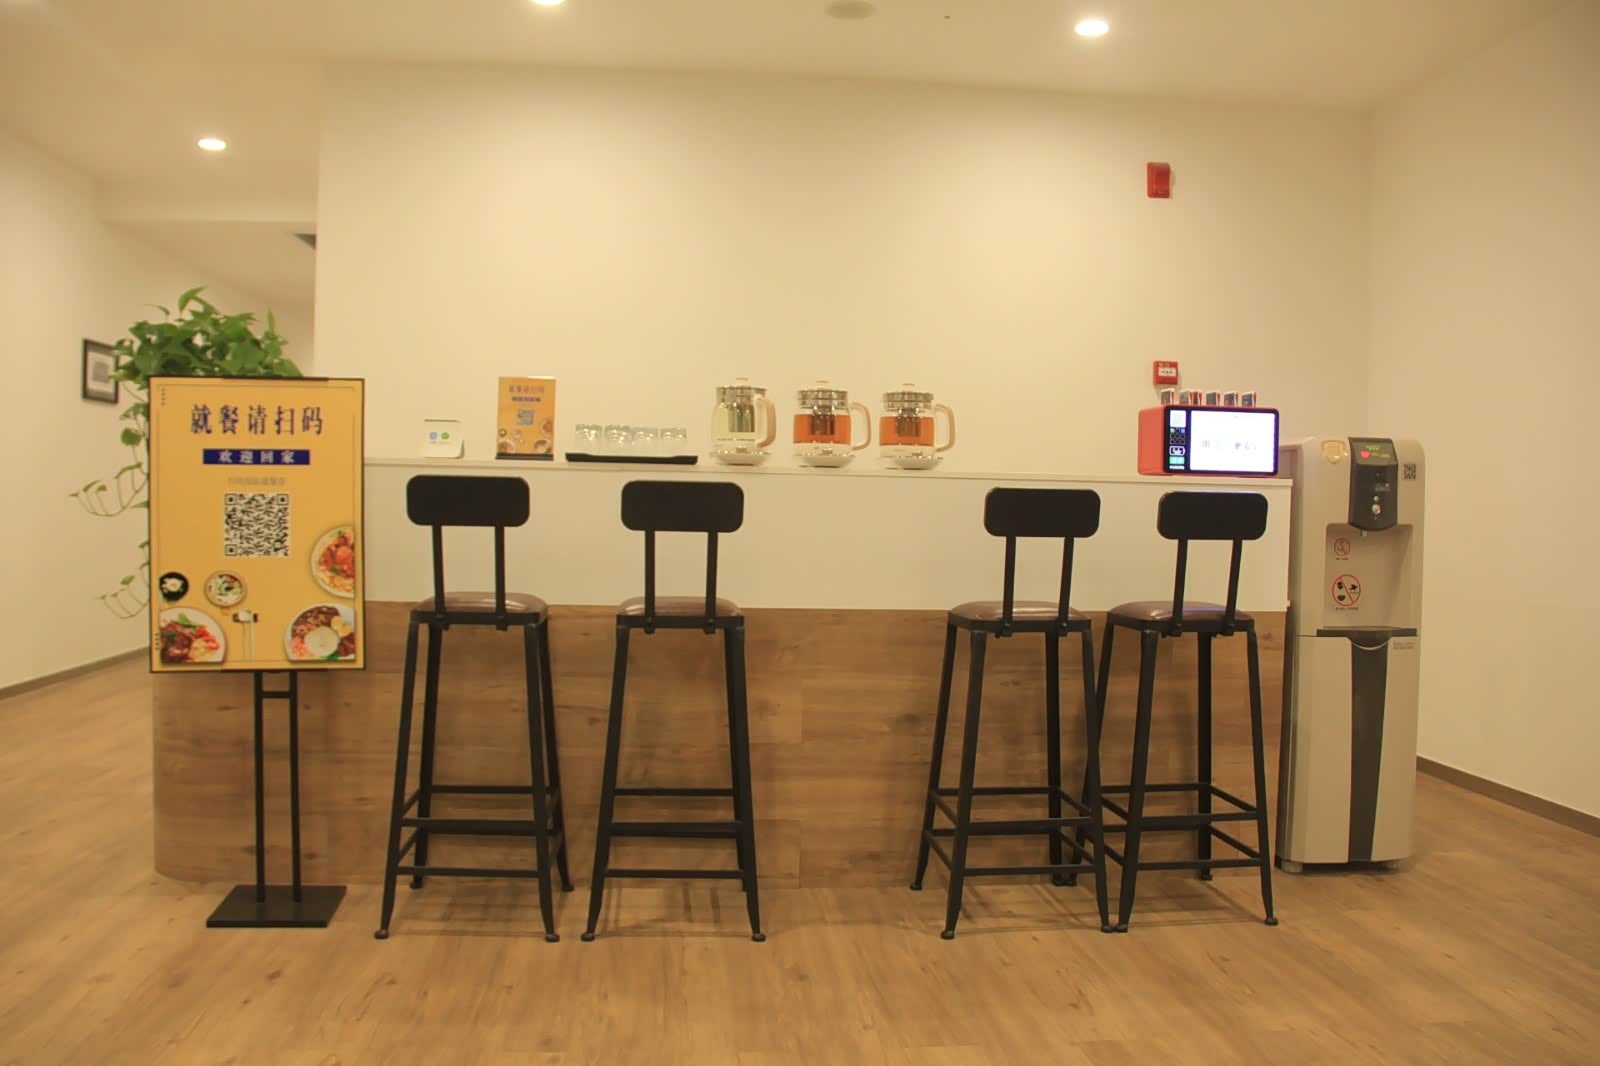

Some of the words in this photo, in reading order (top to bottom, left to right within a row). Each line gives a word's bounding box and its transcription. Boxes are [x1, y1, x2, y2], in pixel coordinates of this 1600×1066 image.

[191, 404, 323, 435] 就餐请扫码
[218, 450, 296, 464] 欢迎回家
